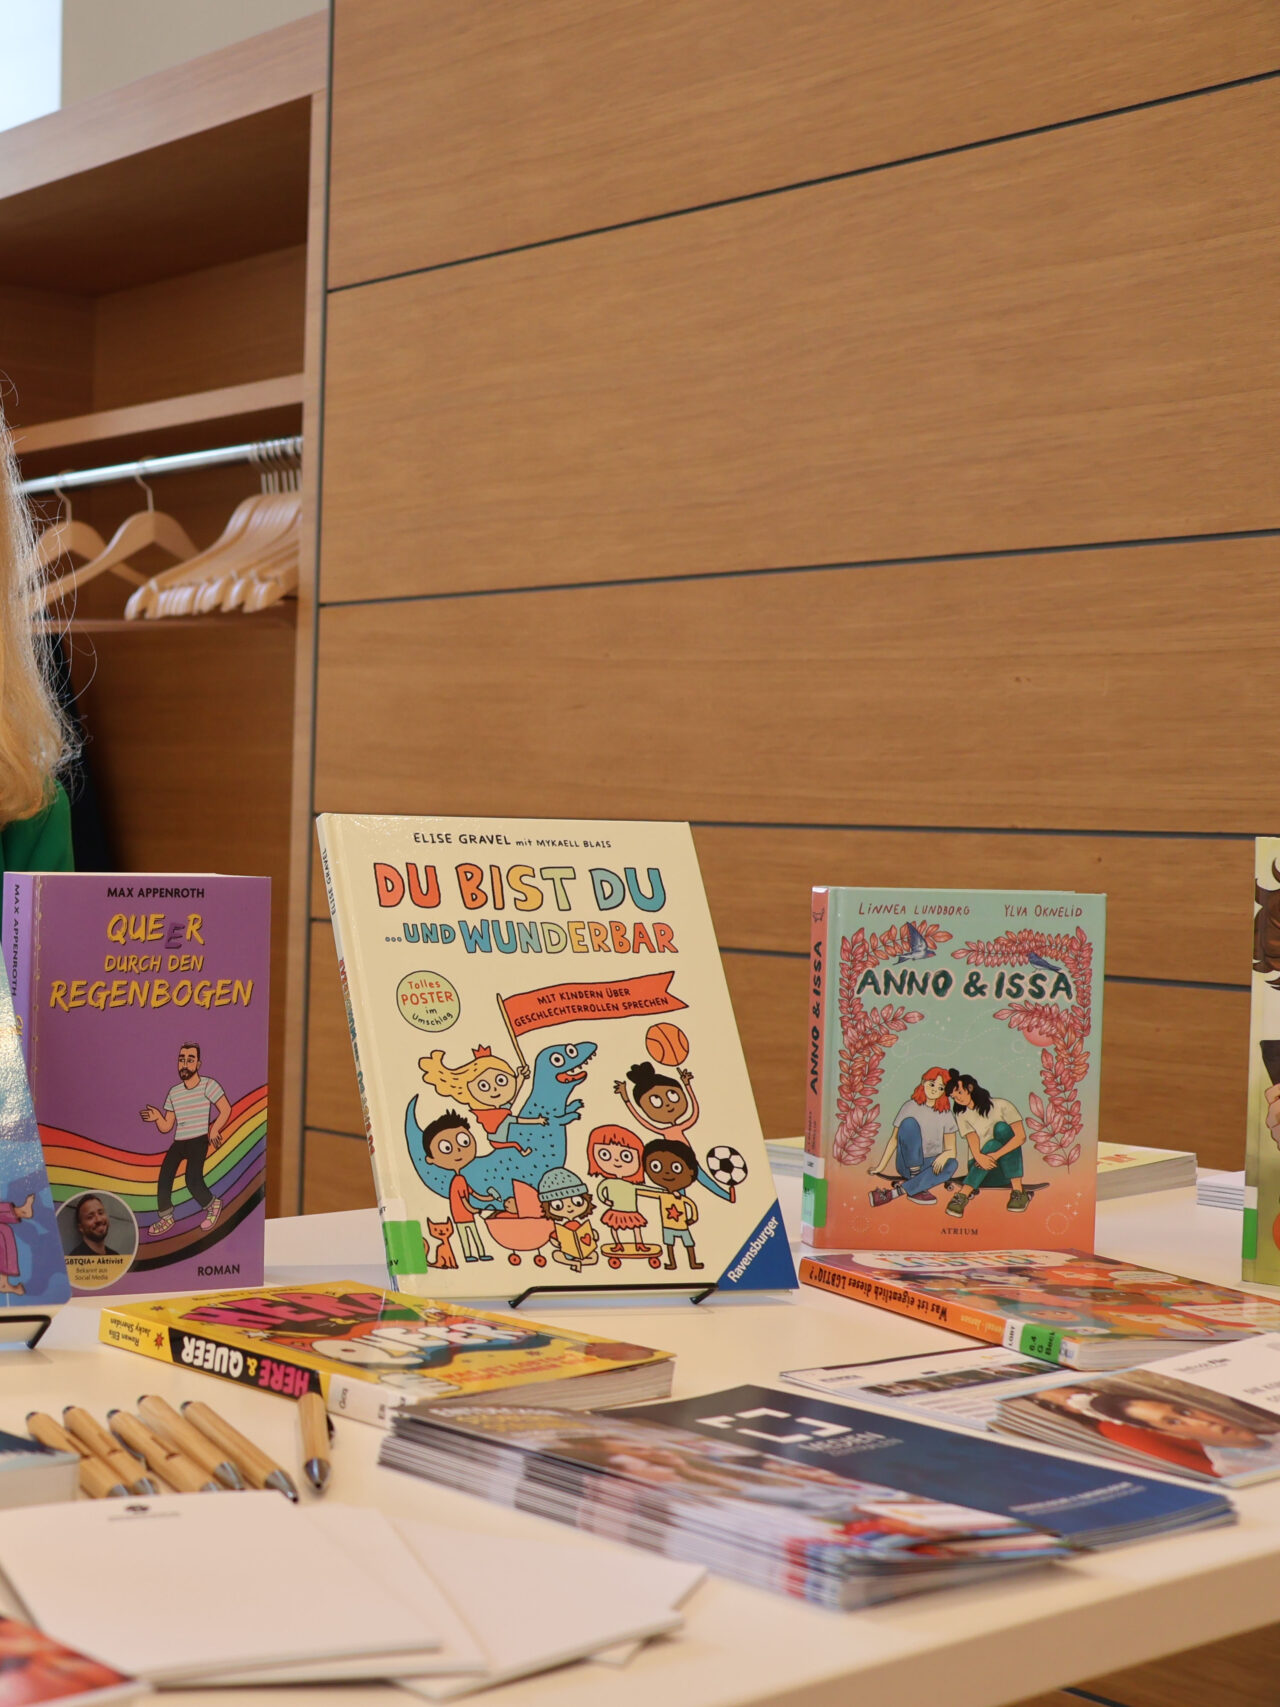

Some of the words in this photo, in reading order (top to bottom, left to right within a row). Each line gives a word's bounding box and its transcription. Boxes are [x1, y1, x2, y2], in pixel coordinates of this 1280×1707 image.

[413, 832, 453, 844] ELISE
[458, 833, 511, 846] GRAVEL
[516, 838, 533, 847] mit
[536, 839, 580, 848] MYKAELL
[583, 839, 612, 849] BLAIS
[107, 887, 134, 898] MAX
[137, 887, 205, 899] APPENROTH
[373, 861, 441, 909] DU
[454, 862, 577, 912] BIST
[588, 866, 667, 913] DU
[914, 904, 970, 916] LUNDBORG
[1004, 904, 1028, 918] YLVA
[106, 912, 206, 950] QUEER
[458, 918, 680, 954] WUNDERBAR
[10, 918, 19, 997] APPENROTH
[104, 955, 163, 974] DURCH
[167, 955, 205, 972] DEN
[813, 941, 822, 996] ISSA
[407, 980, 441, 990] Tolles
[855, 968, 953, 998] ANNO
[963, 971, 989, 998] &
[994, 971, 1073, 1000] ISSA
[49, 978, 255, 1013] REGENBOGEN
[400, 990, 454, 1006] POSTER
[537, 994, 557, 1005] MIT
[559, 989, 603, 1001] KINDERN
[606, 987, 631, 998] ÜBER
[412, 1011, 454, 1026] Umschlag
[425, 1006, 437, 1015] im
[514, 1002, 620, 1027] GESCHLECHTERROLLEN
[621, 997, 669, 1011] SPRECHEN
[810, 1025, 820, 1095] ANNO
[940, 1227, 979, 1236] ATRIUM
[727, 1216, 779, 1283] Ravensburger
[97, 1257, 124, 1265] Aktivist
[197, 1264, 241, 1277] ROMAN
[847, 1277, 872, 1298] dieses
[873, 1285, 915, 1308] eigentlich
[177, 1291, 409, 1330] HERE
[916, 1298, 928, 1314] ist
[930, 1304, 948, 1322] Was
[109, 1317, 135, 1333] Sheridan
[135, 1322, 152, 1337] Jacky
[108, 1329, 121, 1341] Ellis
[121, 1332, 140, 1347] Rowan
[310, 1321, 540, 1366] QUEER
[181, 1335, 244, 1378] QUEER
[246, 1357, 259, 1377] &
[257, 1359, 310, 1397] HERE
